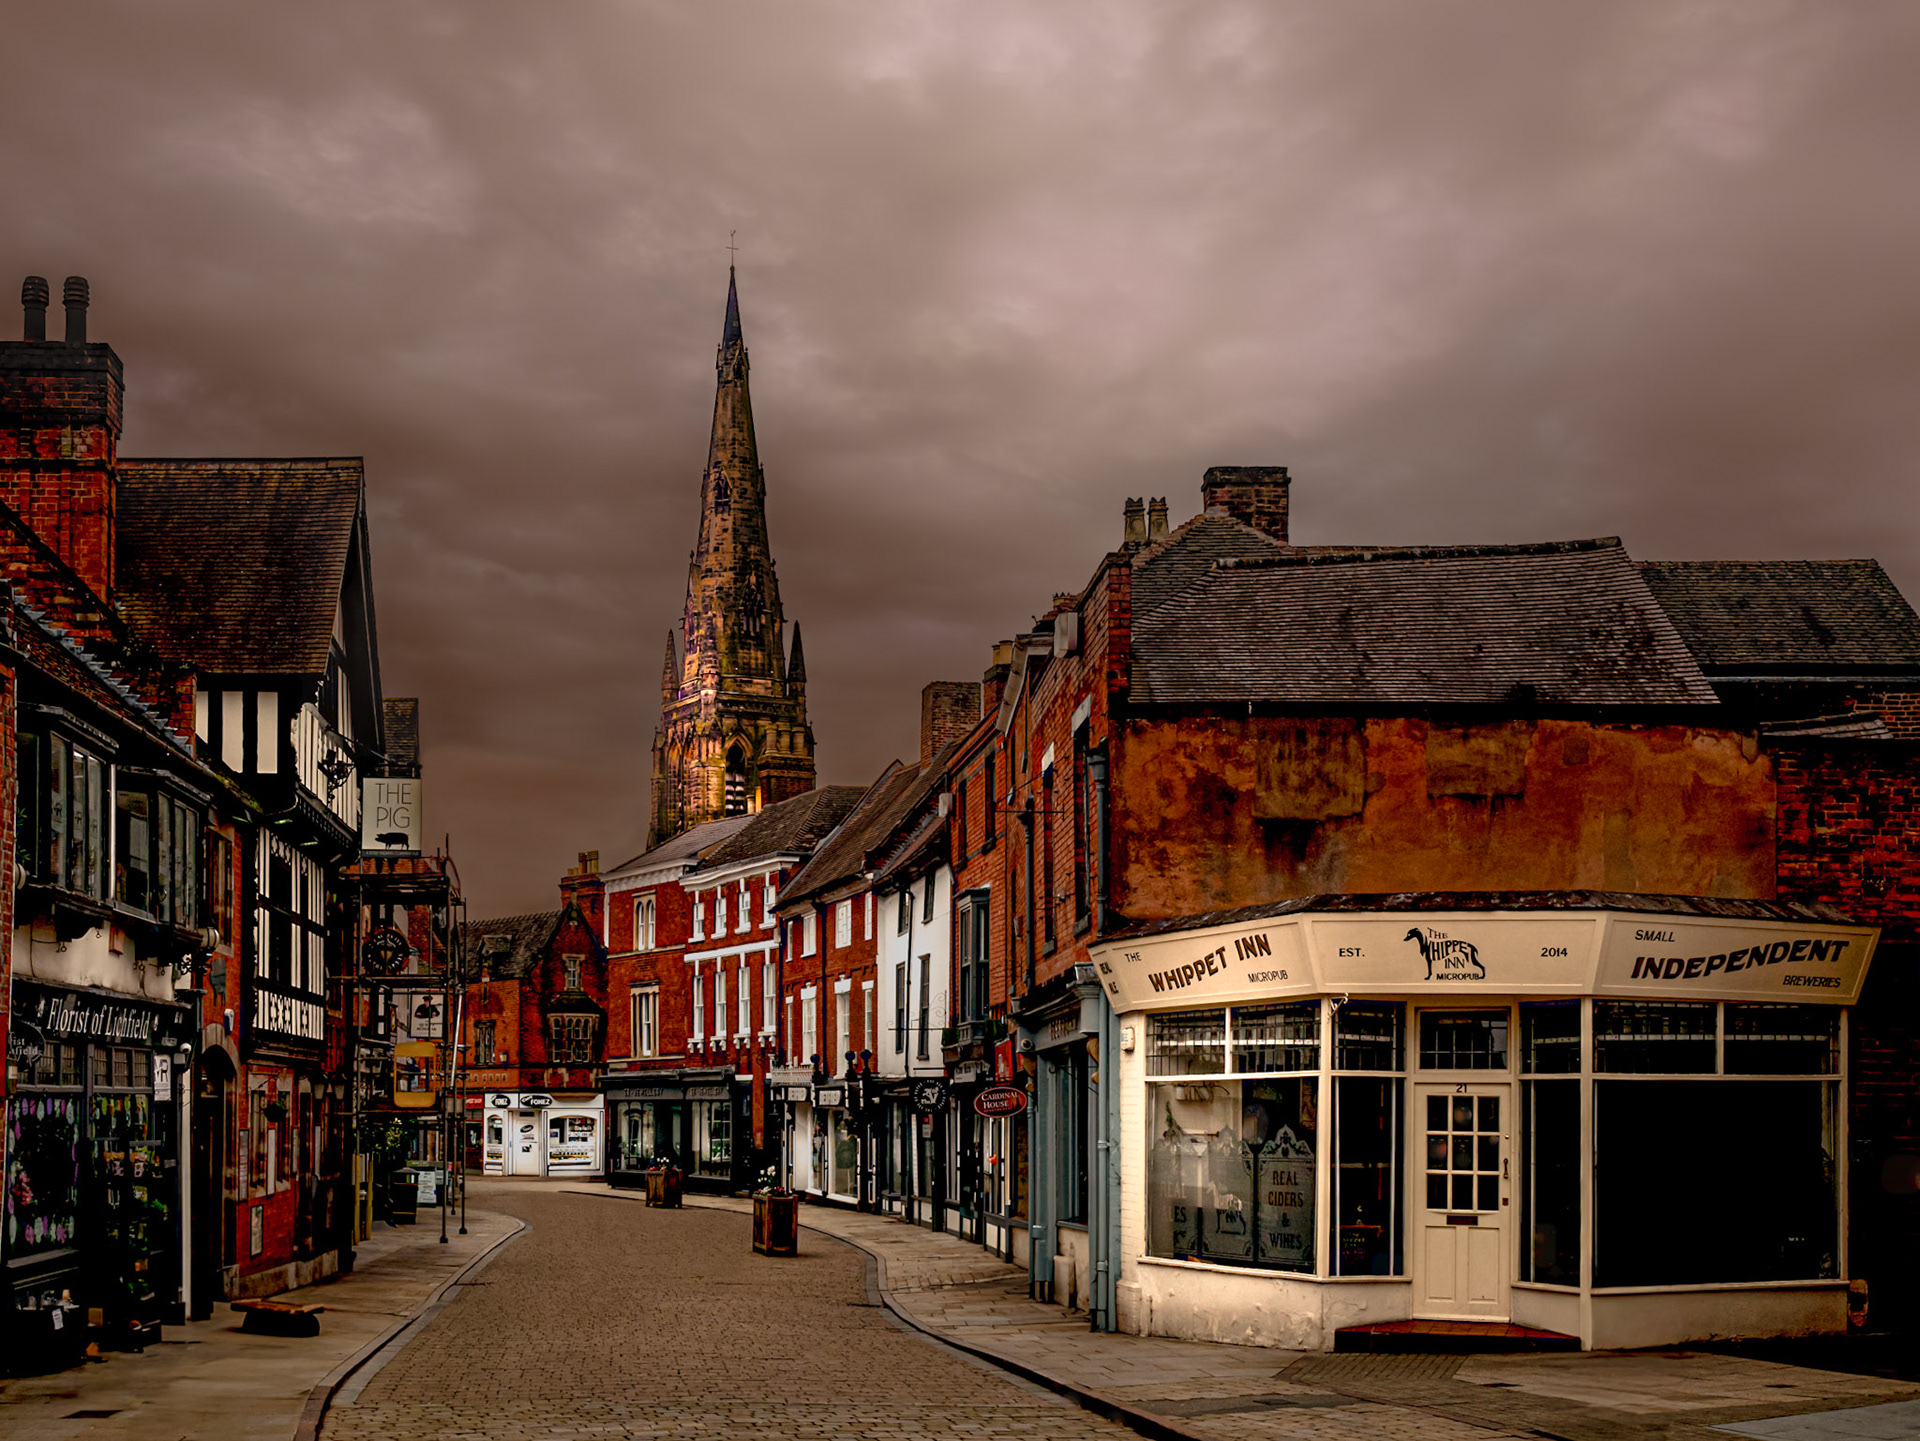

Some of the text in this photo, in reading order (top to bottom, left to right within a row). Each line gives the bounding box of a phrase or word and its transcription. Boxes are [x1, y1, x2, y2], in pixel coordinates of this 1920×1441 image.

[375, 783, 412, 804] THE
[376, 806, 410, 828] PIG
[1427, 927, 1448, 939] THE
[1635, 930, 1675, 942] SMALL
[1339, 948, 1365, 957] EST.
[1422, 939, 1479, 962] WHIPPET
[1540, 947, 1568, 957] 2014
[1124, 952, 1142, 963] THE
[1148, 933, 1272, 993] WHIPPET INN
[1443, 956, 1466, 969] INN
[1631, 939, 1850, 979] INDEPENDENT
[1247, 969, 1289, 983] MICROPUB
[1436, 973, 1480, 981] MICROPUB
[1782, 975, 1841, 988] BREWERIES
[46, 998, 150, 1040] Florist of Lichfield
[1456, 1083, 1467, 1093] 21
[981, 1091, 1018, 1101] CARDINAL
[983, 1100, 1009, 1109] HOUSE
[1272, 1170, 1299, 1186] REAL
[1268, 1191, 1304, 1208] CIDERS
[1281, 1212, 1290, 1228] &
[1269, 1233, 1302, 1250] WINES
